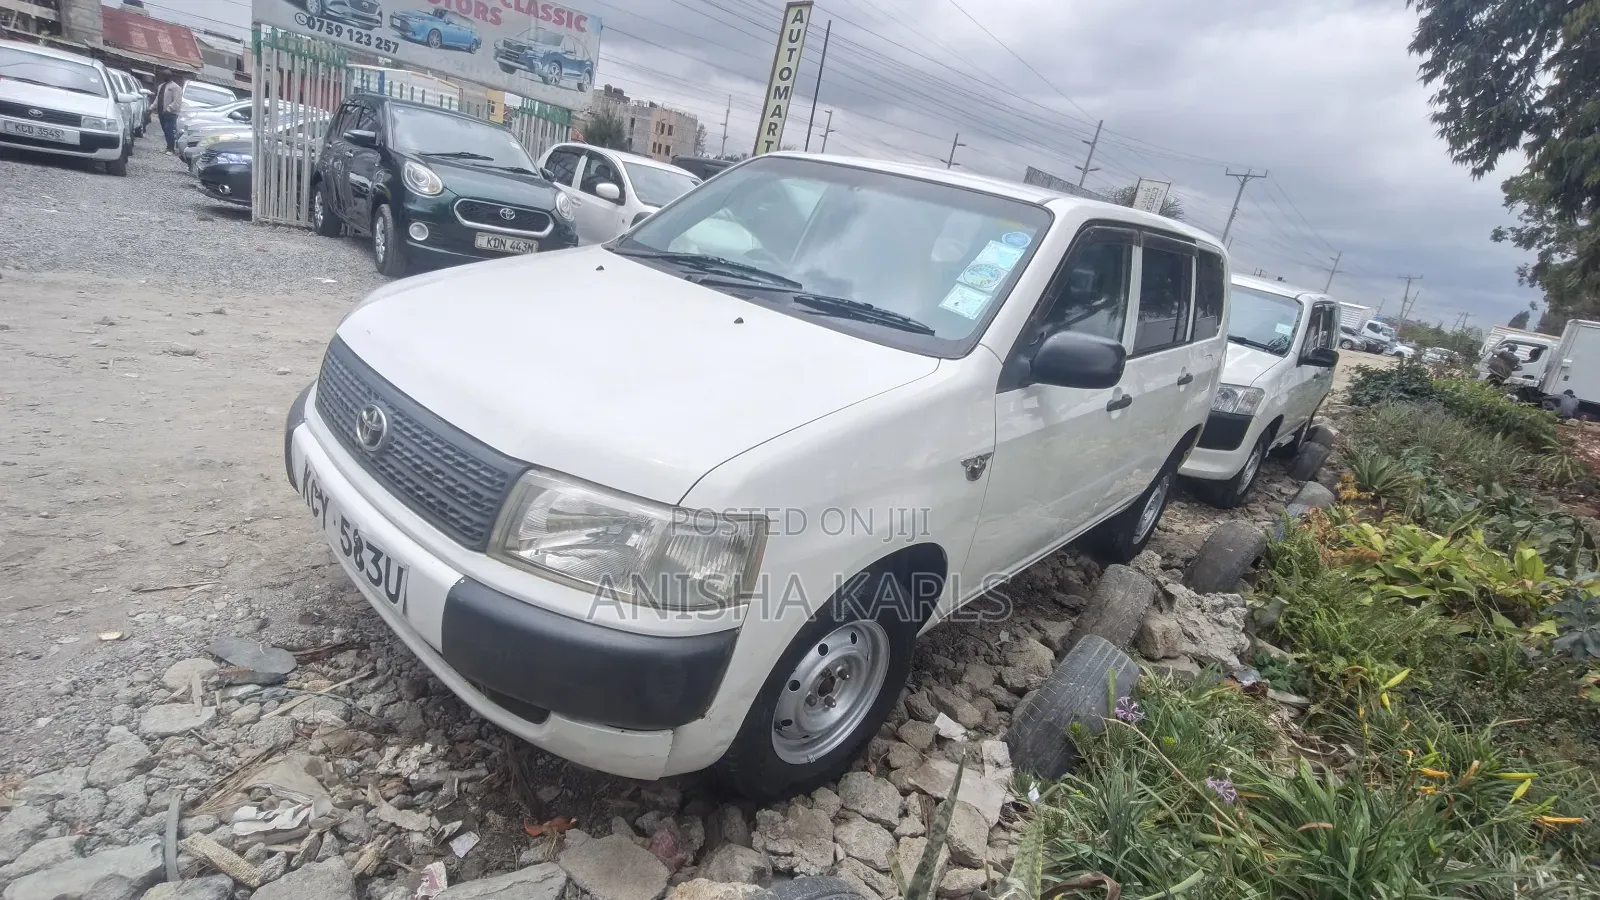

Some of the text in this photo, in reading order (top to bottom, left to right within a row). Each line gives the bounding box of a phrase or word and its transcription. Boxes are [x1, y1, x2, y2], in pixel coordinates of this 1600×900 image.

[306, 16, 399, 54] 0759 123 257
[765, 8, 804, 153] AUTOMART
[487, 236, 507, 250] KDN
[302, 459, 404, 605] KCY 583U
